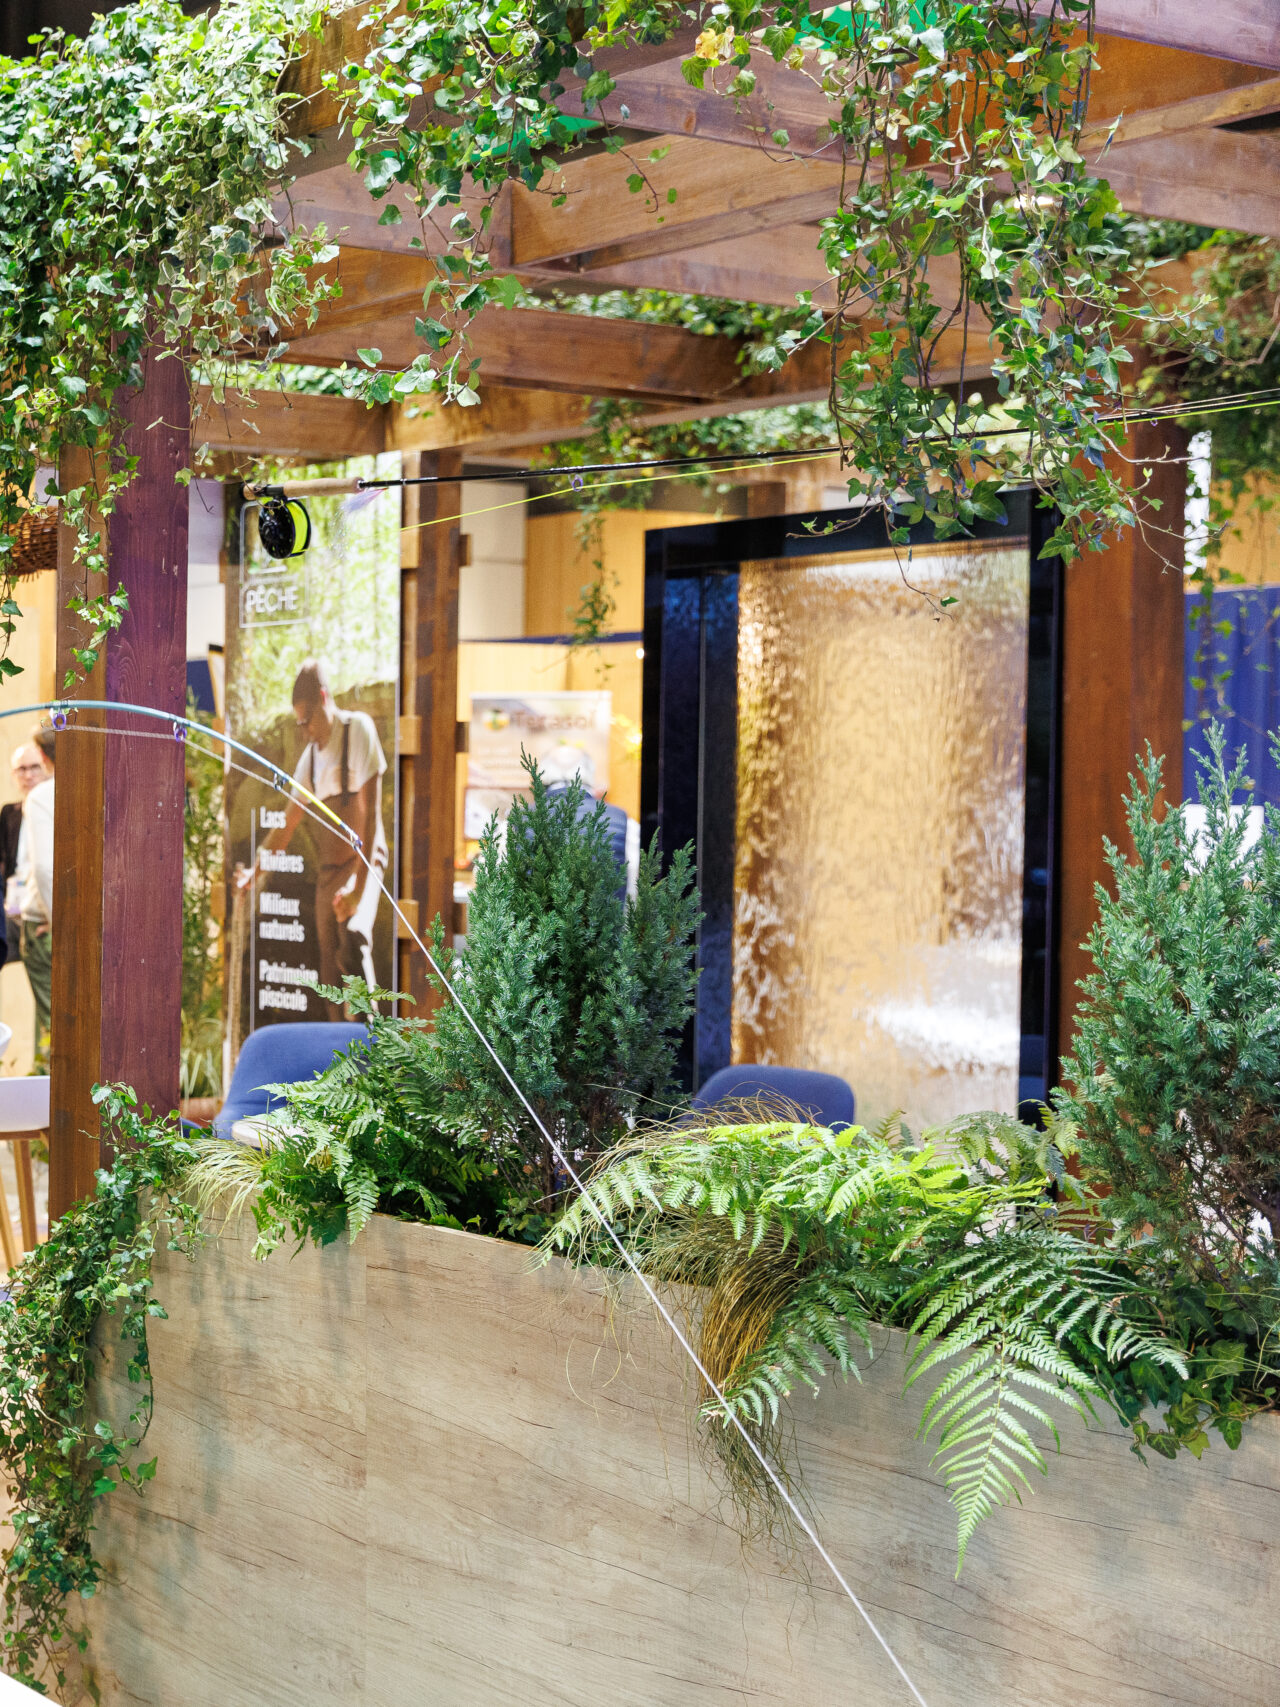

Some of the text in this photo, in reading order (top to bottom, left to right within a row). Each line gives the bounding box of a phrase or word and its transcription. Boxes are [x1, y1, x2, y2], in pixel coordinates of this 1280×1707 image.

[245, 584, 299, 613] PÊCHE
[259, 806, 287, 829] Lacs
[259, 849, 305, 873] Rivières
[259, 891, 301, 917] Milieux
[259, 918, 305, 943] naturels
[259, 958, 319, 987] Patrimoine
[258, 984, 308, 1011] piscicole
